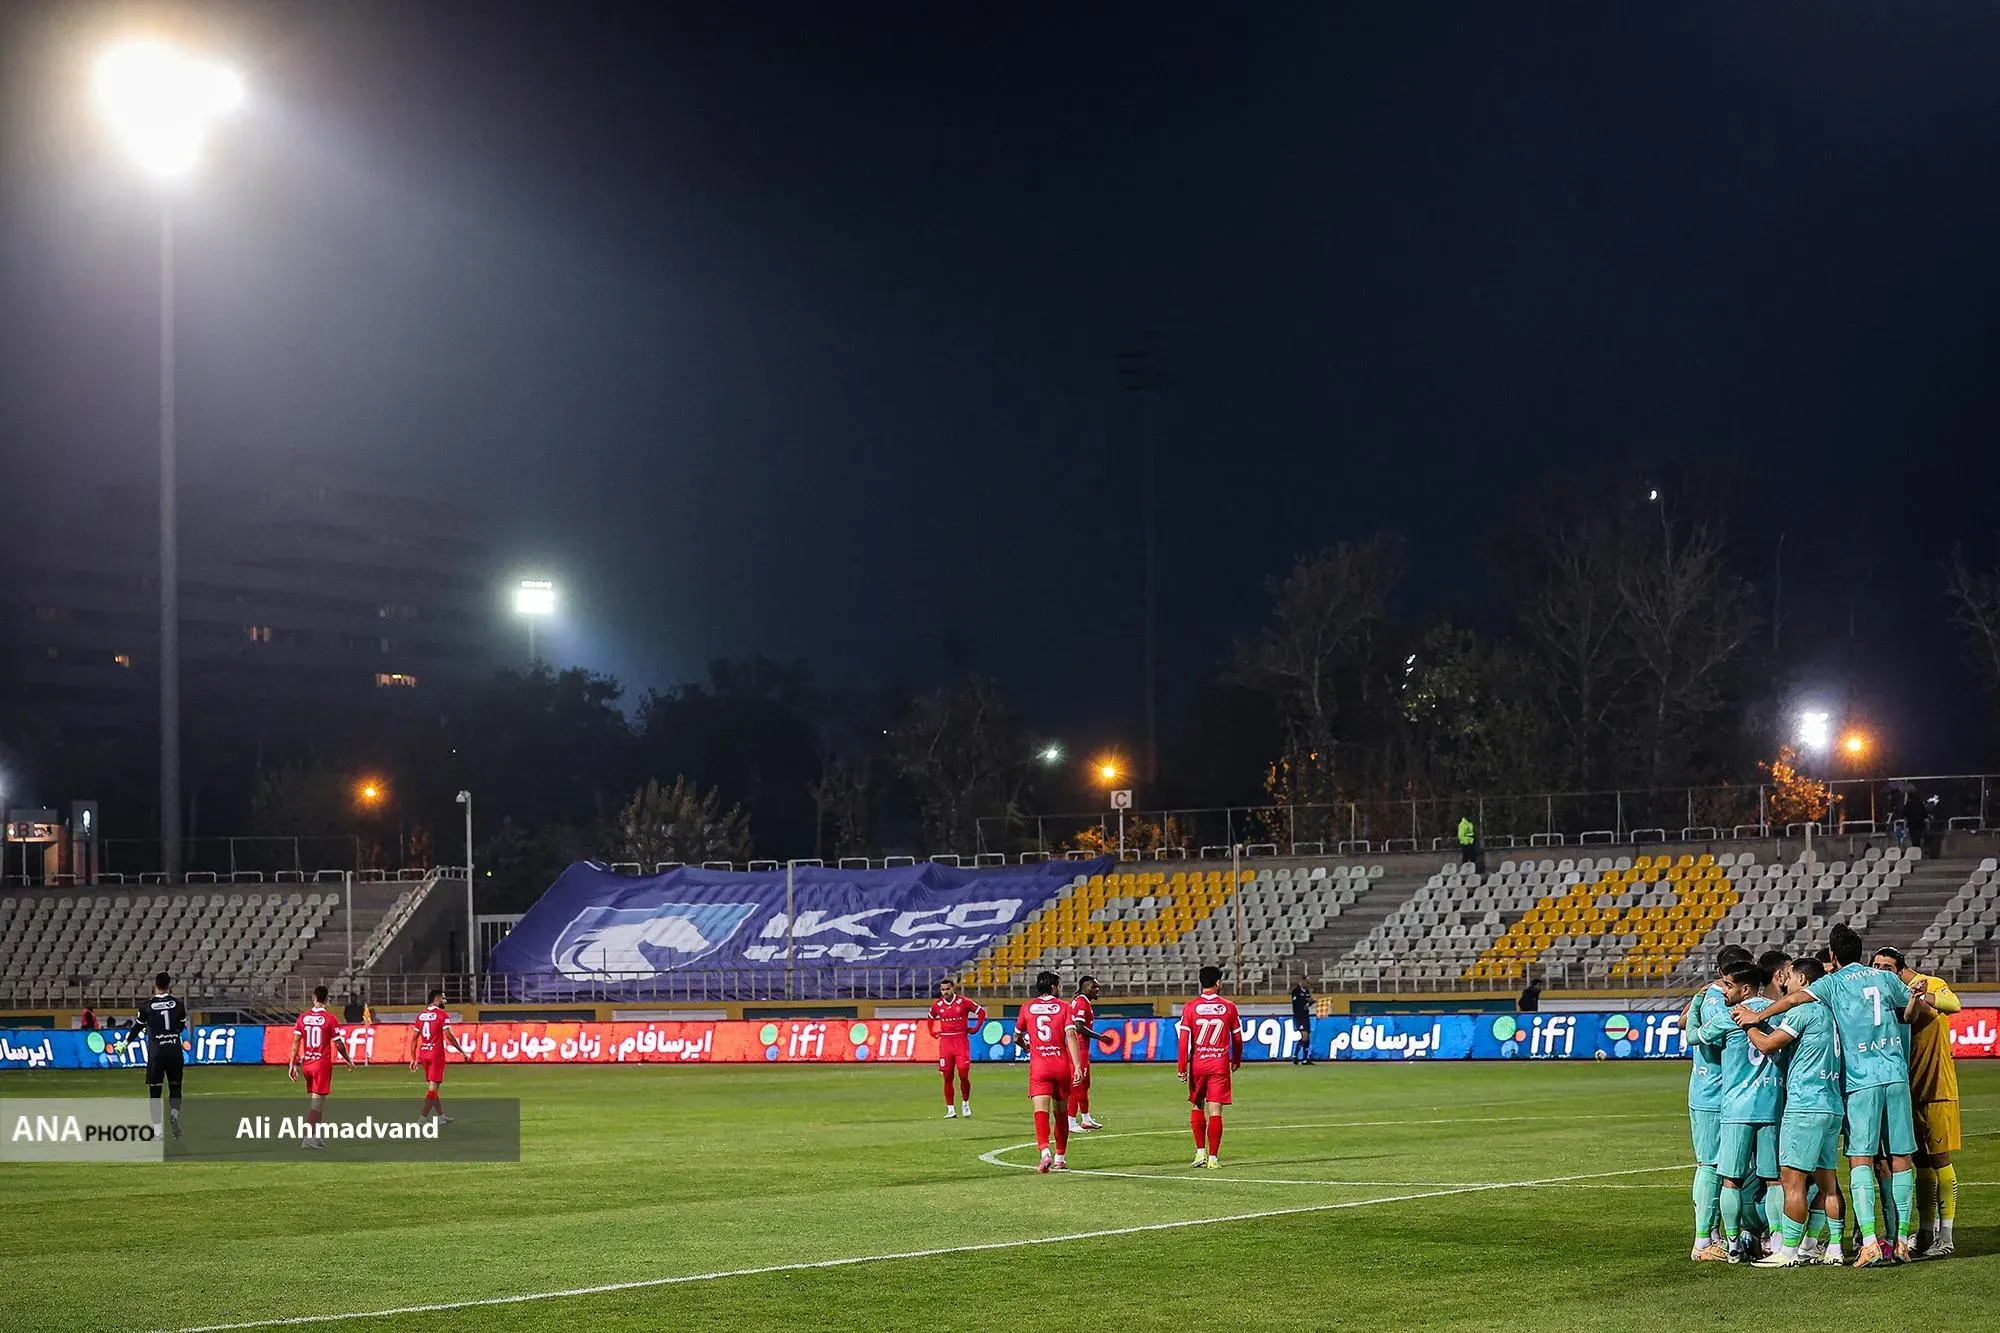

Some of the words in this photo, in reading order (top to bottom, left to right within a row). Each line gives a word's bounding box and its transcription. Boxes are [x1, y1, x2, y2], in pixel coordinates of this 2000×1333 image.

[1114, 792, 1127, 808] C
[759, 899, 1023, 938] IKCO
[160, 1010, 171, 1030] 1
[1863, 986, 1882, 1026] 7
[304, 1026, 322, 1048] 10
[422, 1021, 431, 1040] 4
[788, 1023, 827, 1057] ifi
[878, 1023, 918, 1057] ifi
[1036, 1015, 1052, 1042] 5
[1195, 1018, 1225, 1045] 77
[1330, 1018, 1440, 1059] ایرسافام
[1530, 1016, 1577, 1054] ifi
[196, 1028, 236, 1060] ifi
[481, 1032, 497, 1059] را
[502, 1031, 557, 1059] جهان
[560, 1031, 601, 1059] زبان
[1858, 1036, 1903, 1053] SAFIR
